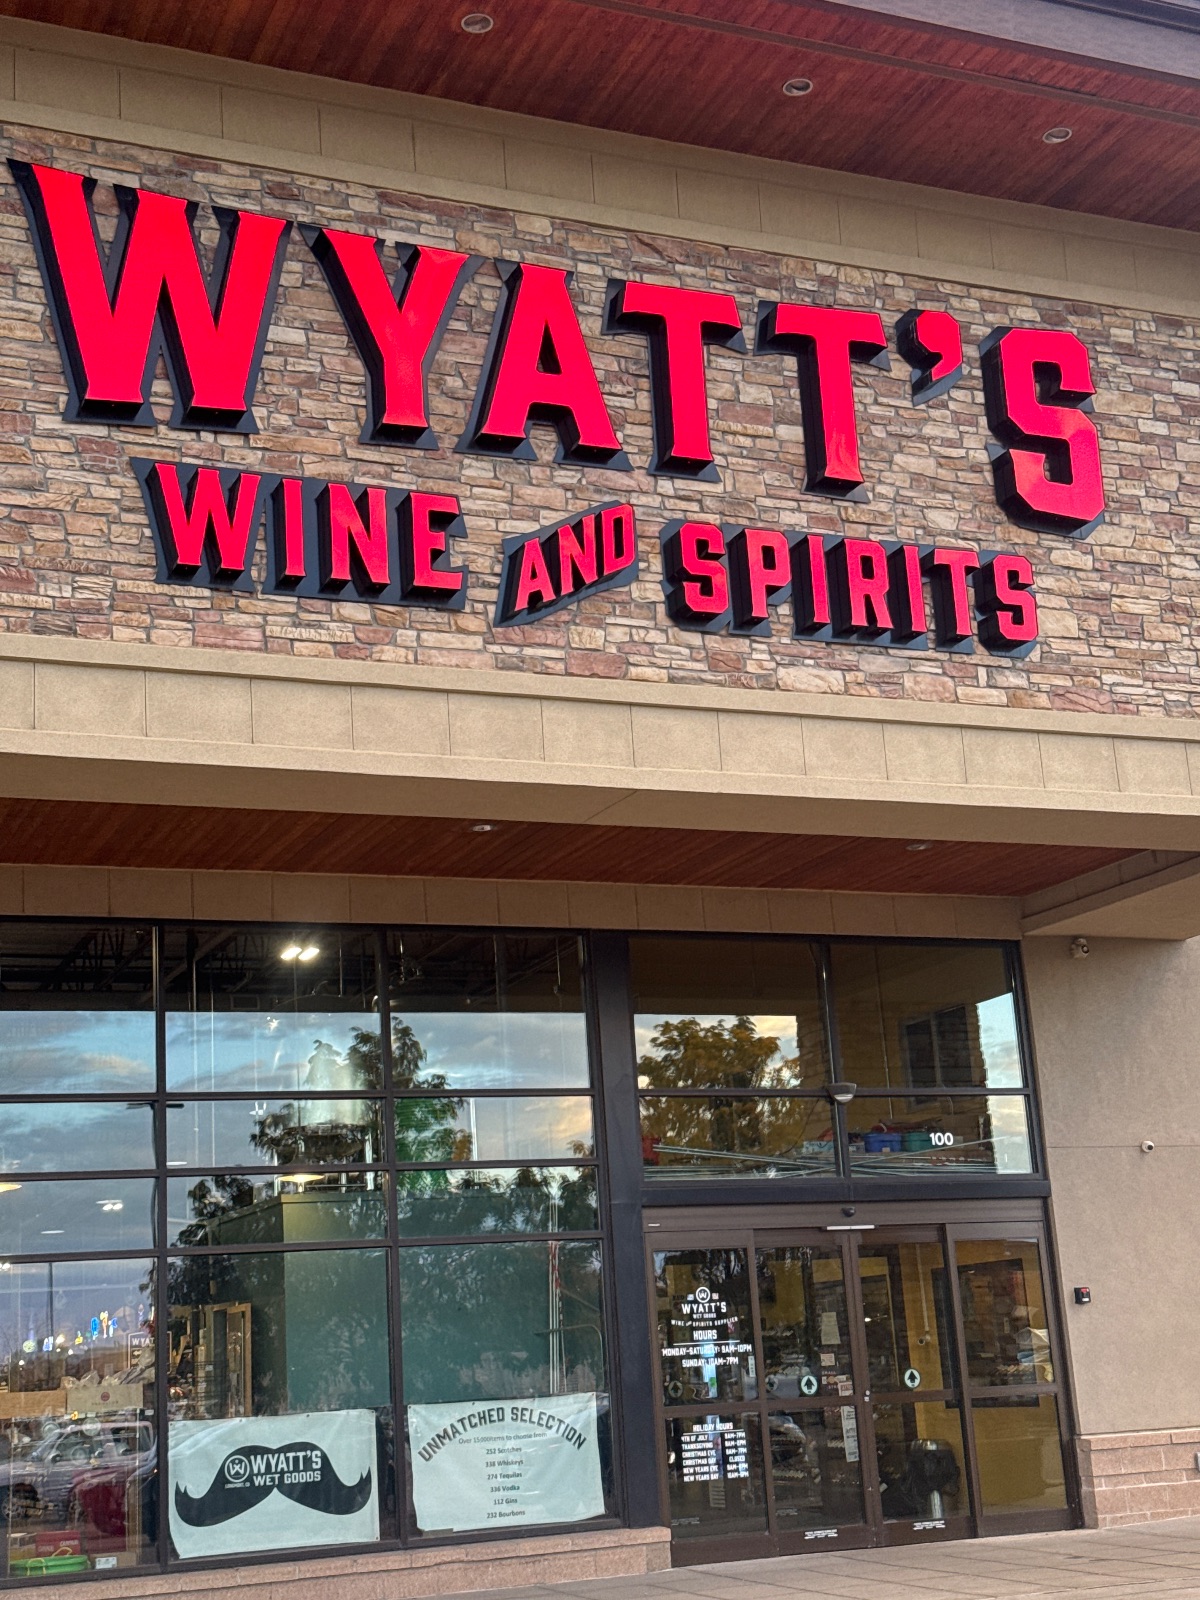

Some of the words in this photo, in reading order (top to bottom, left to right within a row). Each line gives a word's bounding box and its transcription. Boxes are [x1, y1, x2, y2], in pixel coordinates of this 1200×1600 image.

[30, 162, 1106, 523] WYATT'S
[153, 462, 462, 590] WINE
[512, 502, 636, 612] AND
[679, 522, 1039, 642] SPIRITS
[929, 1132, 954, 1146] 100
[681, 1302, 727, 1314] WYATT'S
[693, 1329, 717, 1340] HOURS
[417, 1407, 505, 1462] UNMATCHED
[510, 1406, 588, 1451] SELECTION
[250, 1450, 322, 1474] WYATT'S
[253, 1474, 280, 1487] WET
[284, 1470, 321, 1484] GOODS
[499, 1471, 523, 1479] Tequilas
[498, 1510, 526, 1518] Bourbons
